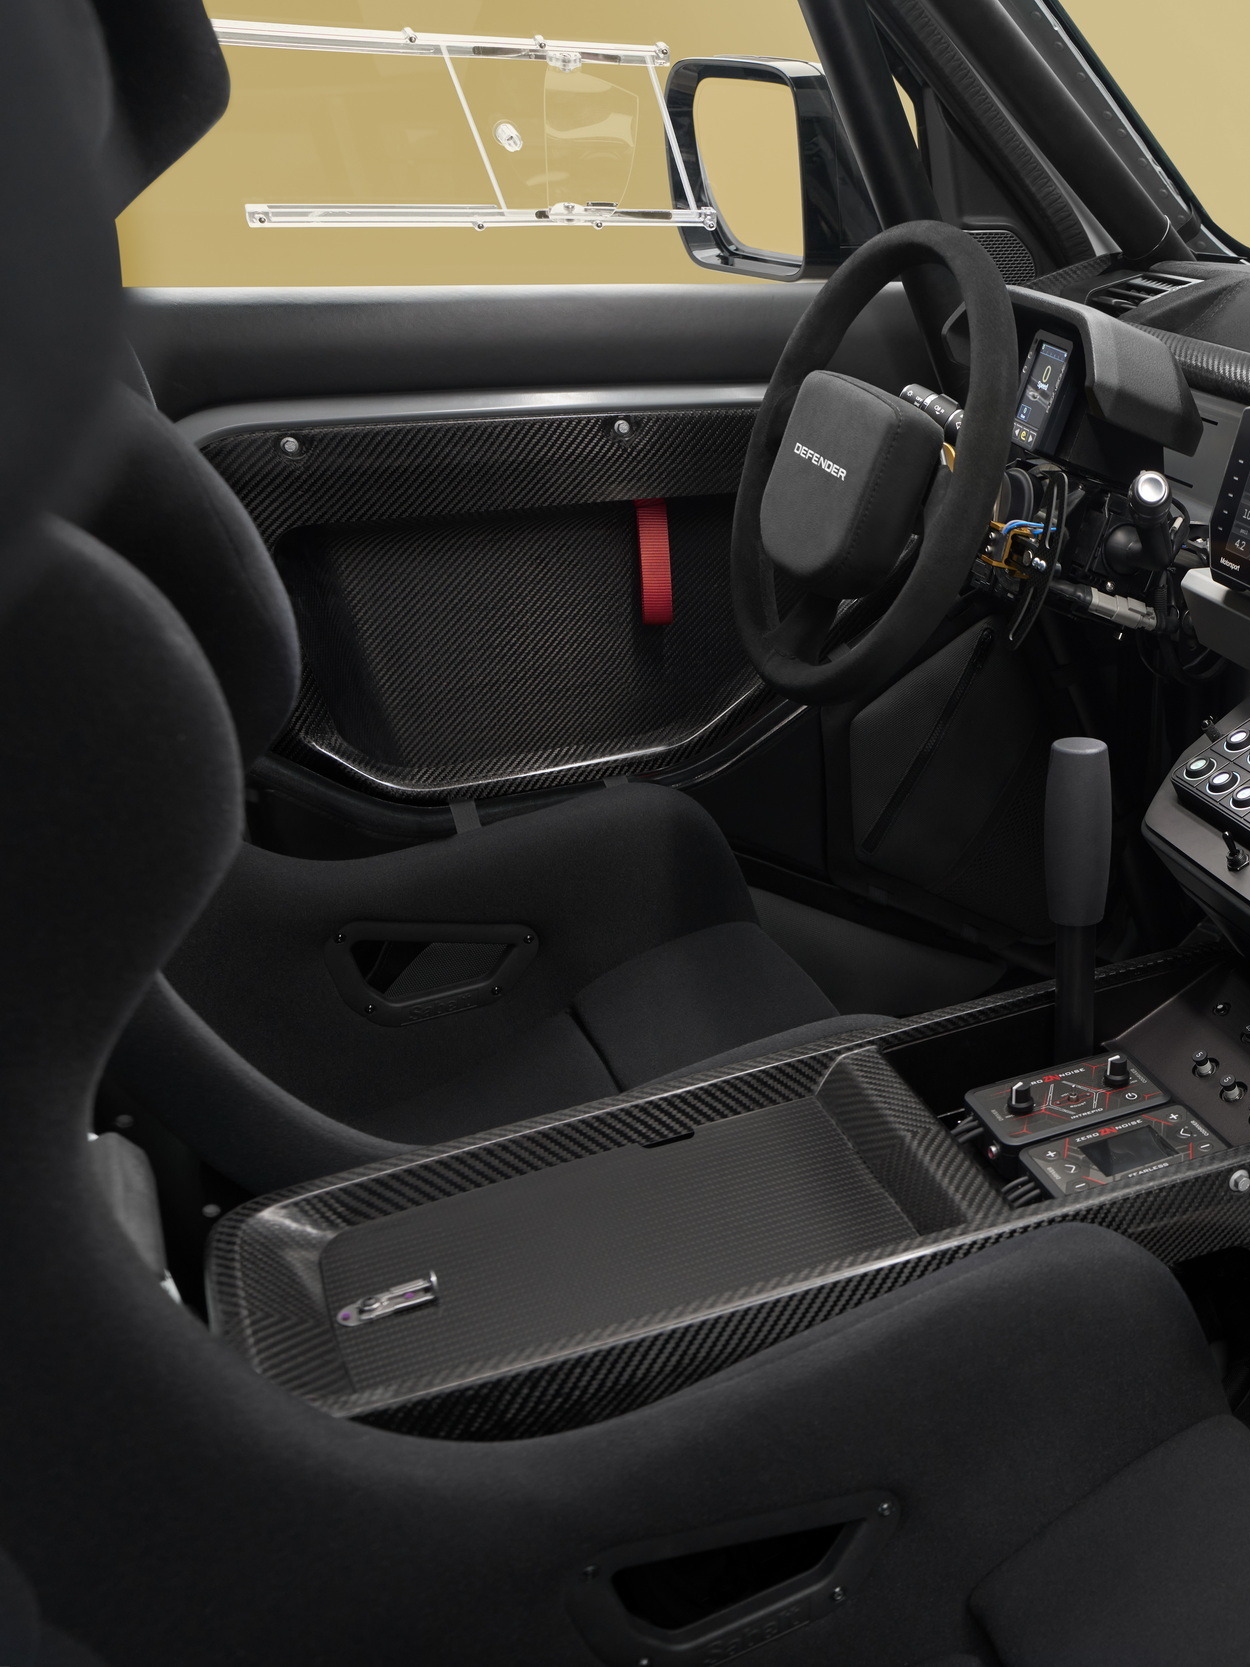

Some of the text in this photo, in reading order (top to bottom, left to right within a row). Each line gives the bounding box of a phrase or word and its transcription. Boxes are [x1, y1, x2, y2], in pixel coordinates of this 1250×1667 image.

[1042, 365, 1052, 383] 0
[794, 442, 848, 482] DEFENDER
[1233, 540, 1246, 552] 4.2
[1196, 1051, 1203, 1059] 5
[1058, 1068, 1086, 1080] NOISE
[1224, 1076, 1232, 1084] 5
[1070, 1107, 1104, 1121] INTREPID
[1075, 1131, 1100, 1143] ZERO
[1115, 1119, 1144, 1131] NOISE
[1128, 1162, 1170, 1179] FEARLESS
